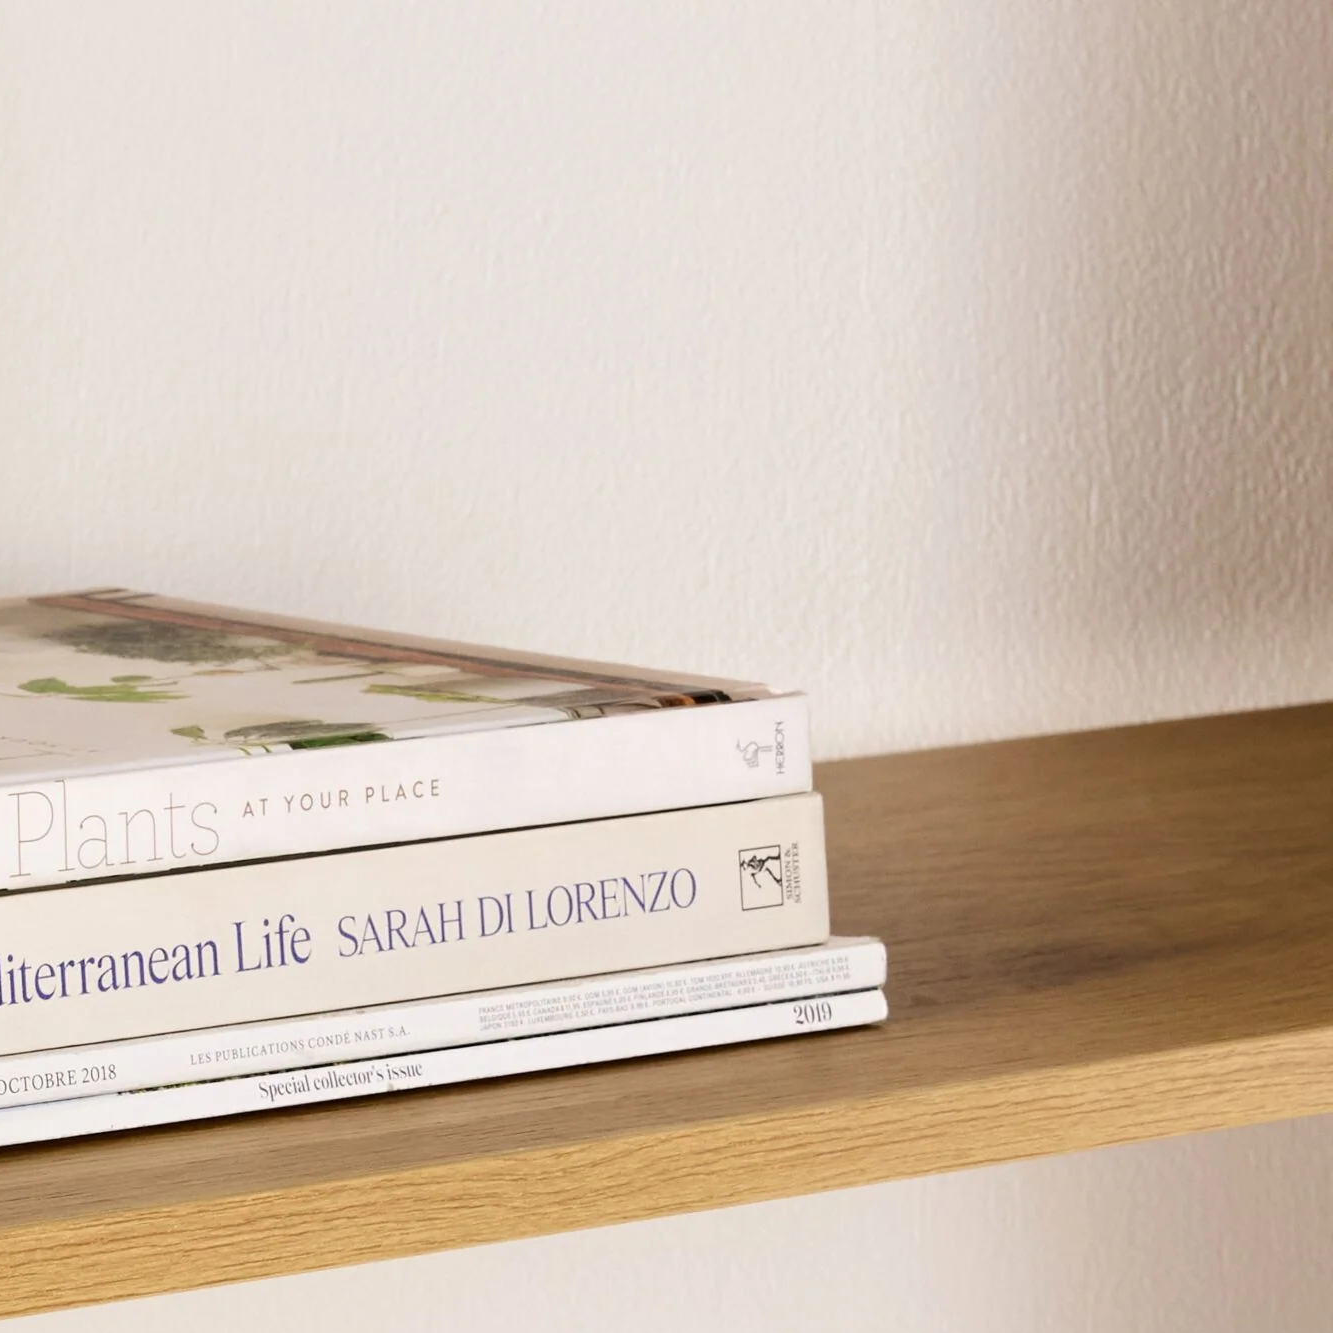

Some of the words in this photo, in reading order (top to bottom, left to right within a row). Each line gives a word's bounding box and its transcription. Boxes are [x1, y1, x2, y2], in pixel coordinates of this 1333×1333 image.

[775, 721, 784, 775] HERRON
[8, 779, 220, 879] Plants
[243, 798, 272, 818] AT
[285, 789, 349, 813] YOUR
[365, 779, 441, 806] PLACE
[234, 913, 313, 973] Life
[338, 902, 464, 959] SARAH
[478, 895, 513, 937] DI
[527, 867, 697, 932] LORENZO
[793, 1001, 833, 1025] 2019
[190, 1053, 211, 1065] LES
[215, 1039, 305, 1063] PUBLICATIONS
[308, 1030, 350, 1048] CONDÉ
[355, 1028, 385, 1042] NAST
[82, 1064, 117, 1083] 2018
[258, 1073, 311, 1102] Special
[314, 1065, 384, 1091] collector's
[386, 1061, 423, 1081] issue
